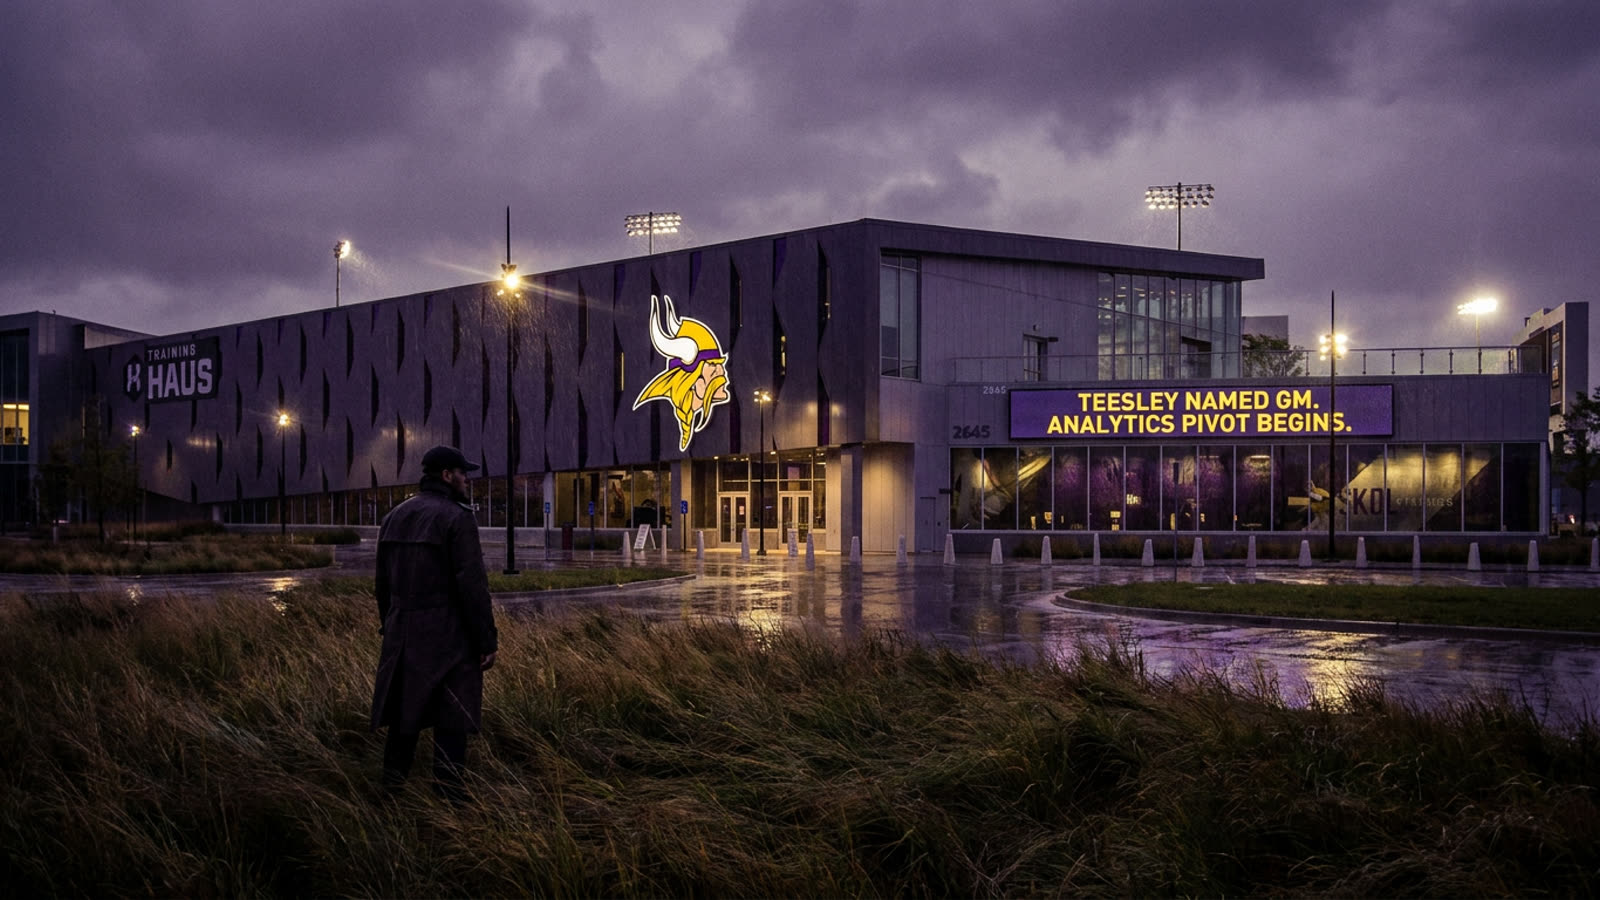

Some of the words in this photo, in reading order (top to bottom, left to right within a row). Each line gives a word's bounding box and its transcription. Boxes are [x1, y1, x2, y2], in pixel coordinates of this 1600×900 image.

[147, 358, 213, 399] HAUS
[1078, 391, 1179, 411] TEESLEY
[1185, 391, 1270, 411] NAMED
[1276, 389, 1320, 410] GM.
[952, 424, 991, 440] 2645
[1046, 414, 1175, 434] ANALYTICS
[1183, 413, 1251, 433] PIVOT
[1257, 412, 1353, 432] BEGINS.
